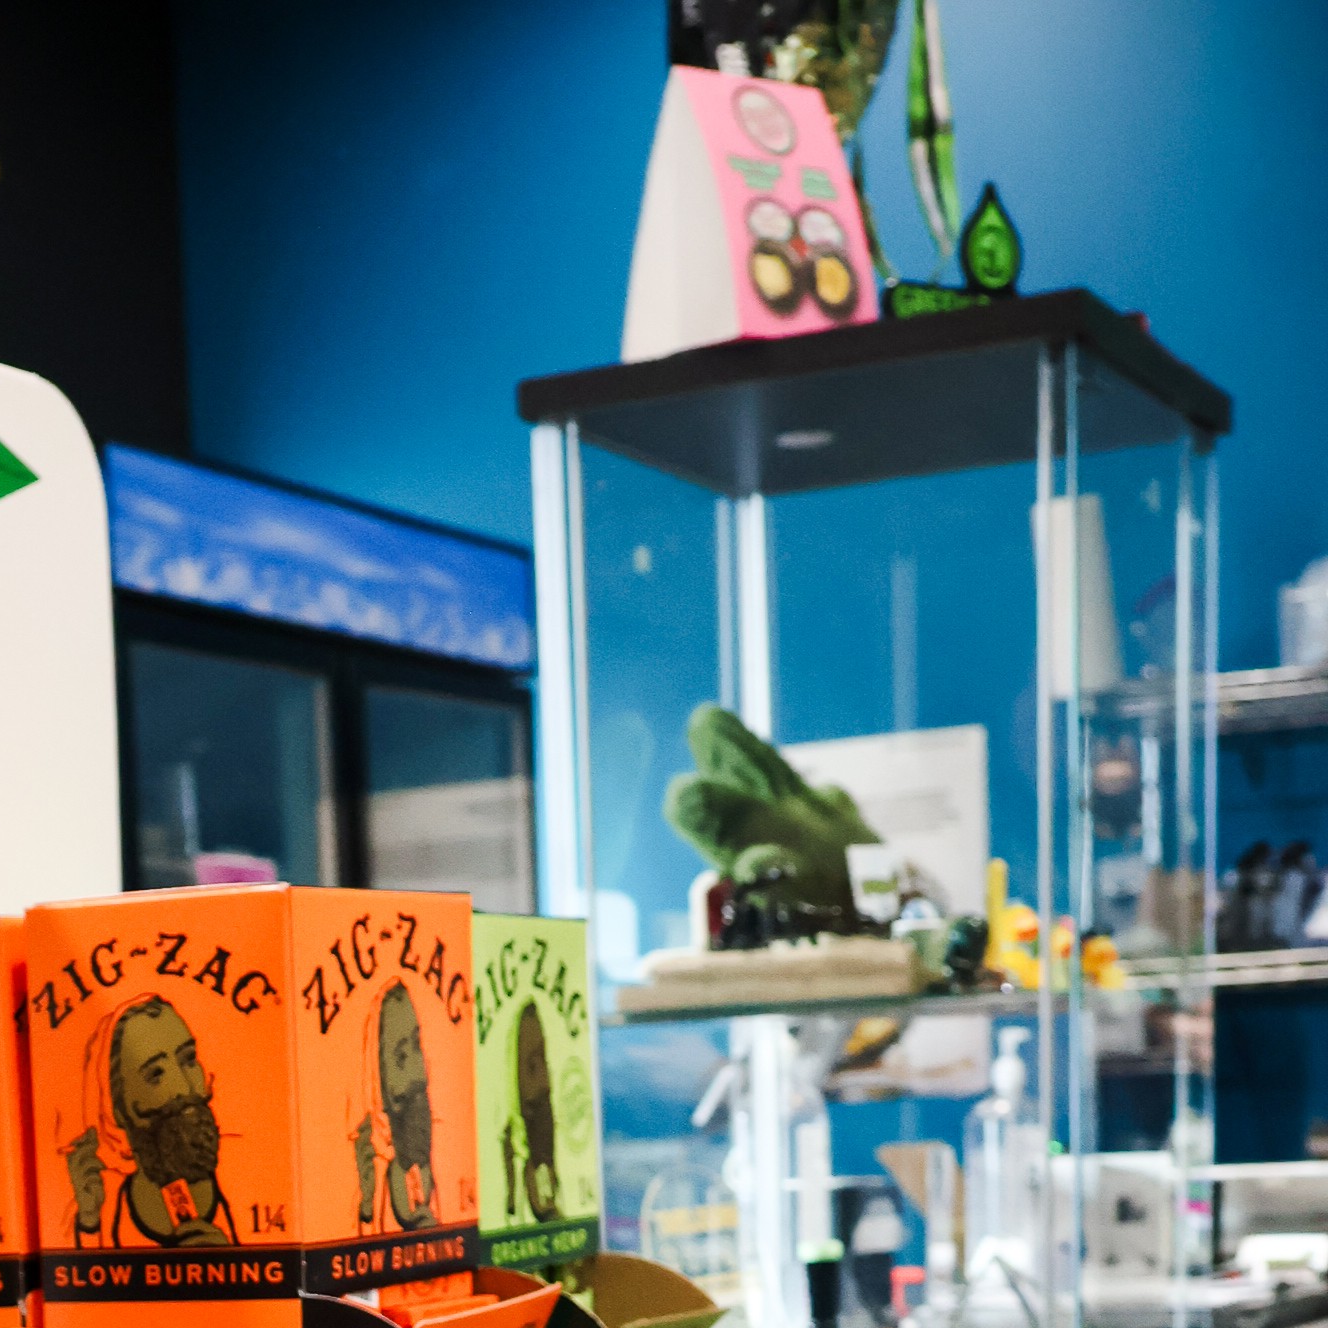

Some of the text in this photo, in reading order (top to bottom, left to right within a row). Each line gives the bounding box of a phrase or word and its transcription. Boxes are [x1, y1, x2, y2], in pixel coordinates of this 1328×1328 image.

[34, 933, 281, 1029] ZIG-ZAG
[303, 912, 470, 1035] ZIG-ZAG
[54, 1260, 284, 1287] SLOW BURNING
[331, 1236, 465, 1280] SLOW BURNING
